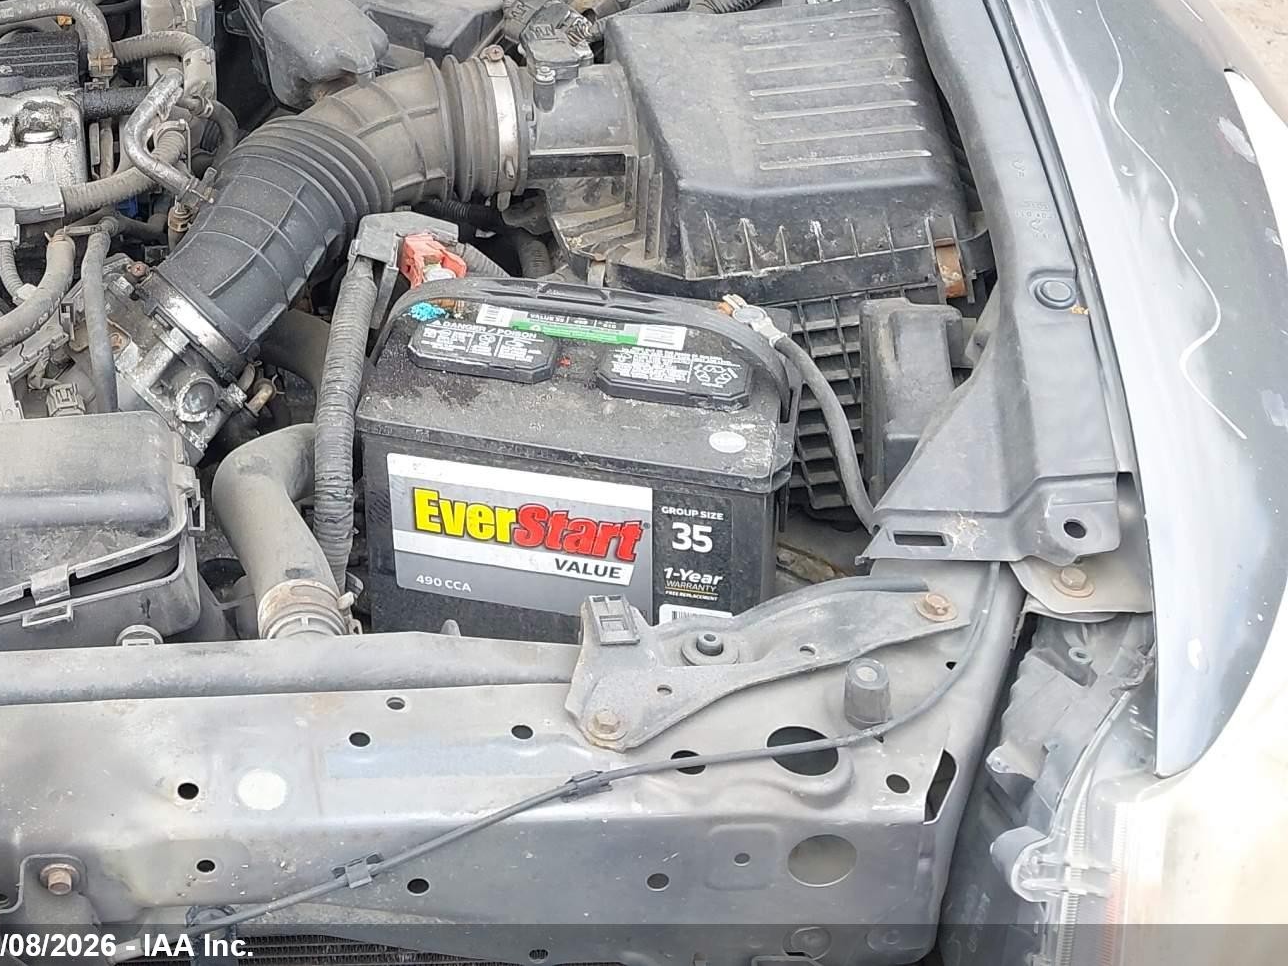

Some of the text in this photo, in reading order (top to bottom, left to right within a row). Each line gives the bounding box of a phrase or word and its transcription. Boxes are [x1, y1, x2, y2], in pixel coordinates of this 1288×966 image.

[442, 320, 487, 333] DANGER
[661, 505, 724, 521] GROUP SIZE
[412, 486, 644, 562] EverStart
[671, 521, 713, 553] 35
[554, 557, 622, 580] VALUE
[663, 566, 724, 586] 1-Year
[415, 574, 472, 593] 490 CCA
[666, 579, 718, 592] WARRANTY
